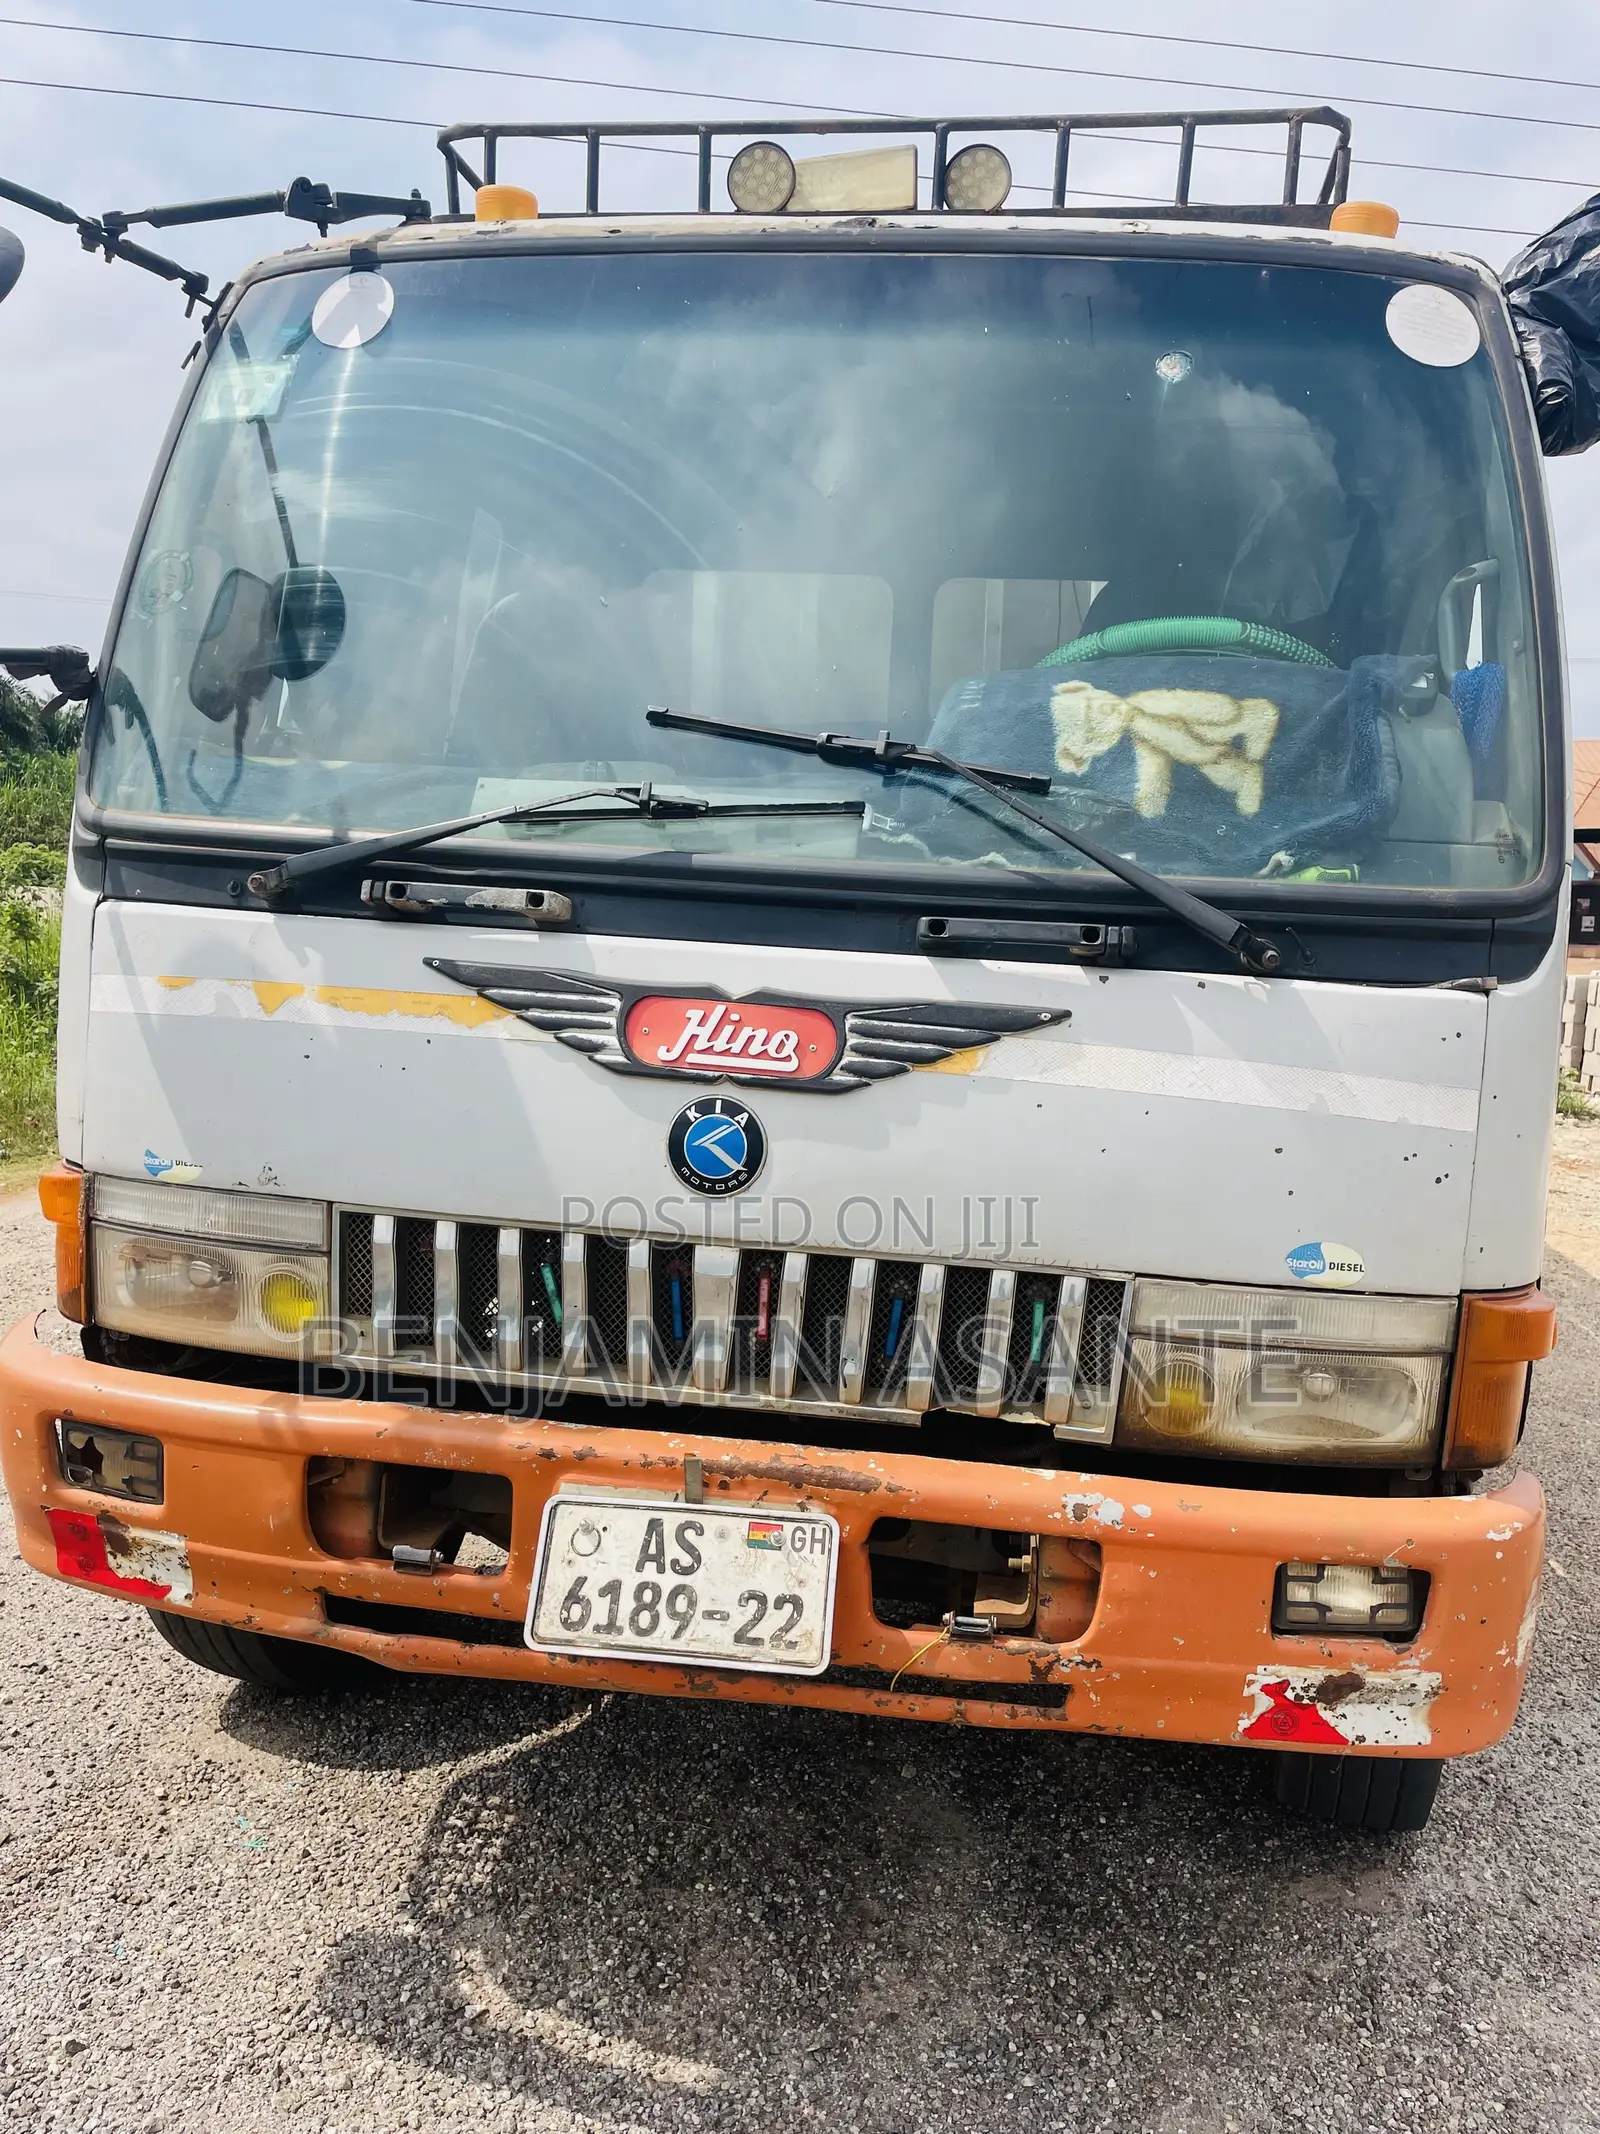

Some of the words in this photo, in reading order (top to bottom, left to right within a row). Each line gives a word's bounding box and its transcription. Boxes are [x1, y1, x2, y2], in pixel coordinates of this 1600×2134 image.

[657, 1004, 799, 1071] Hino
[685, 1099, 750, 1128] KIA
[681, 1166, 748, 1191] MOTORS
[1286, 1257, 1324, 1270] StarOil
[1328, 1262, 1365, 1272] DIESEL
[635, 1518, 705, 1576] AS
[790, 1525, 827, 1556] GH
[560, 1575, 804, 1650] 6189-22
